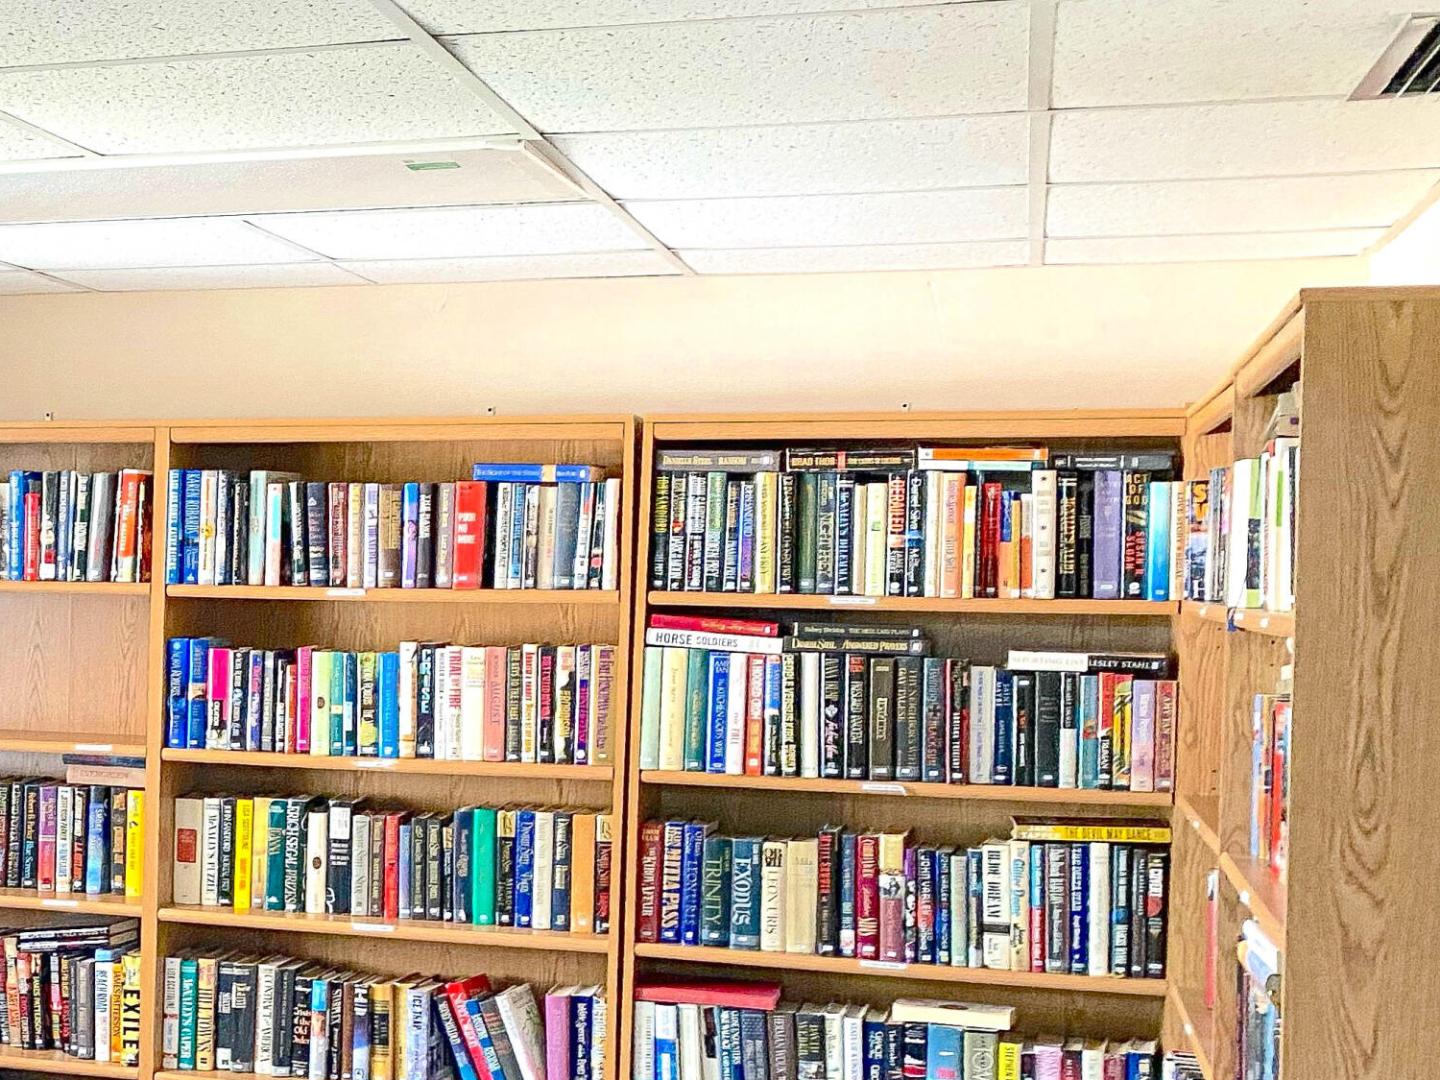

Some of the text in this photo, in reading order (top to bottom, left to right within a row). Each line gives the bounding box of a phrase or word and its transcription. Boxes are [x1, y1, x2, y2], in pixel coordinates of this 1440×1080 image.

[890, 480, 906, 533] DERAILED
[655, 632, 739, 648] HORSE SOLDIERS
[449, 650, 462, 678] TRIAL
[449, 688, 461, 709] FIRE
[704, 856, 723, 926] TRINITY
[732, 858, 753, 926] EXODUS
[661, 892, 679, 929] PASS
[122, 989, 141, 1050] EXILE
[1004, 1046, 1016, 1078] STEPHEN
